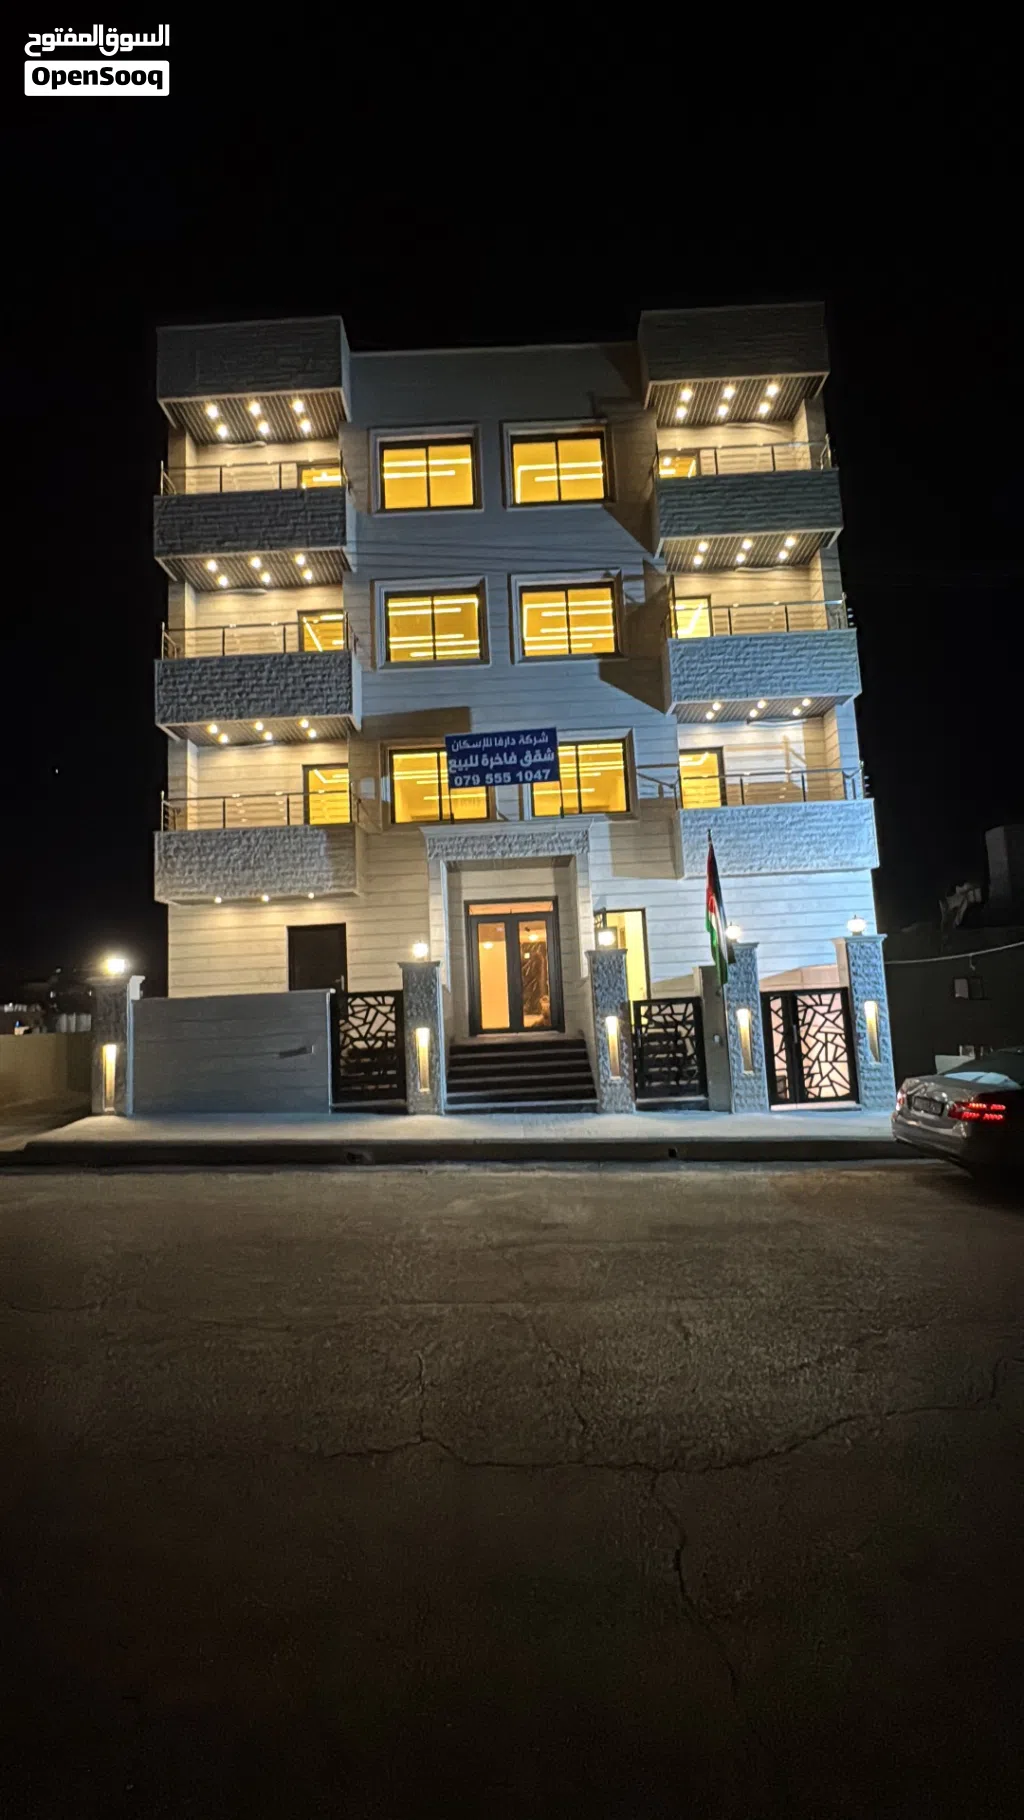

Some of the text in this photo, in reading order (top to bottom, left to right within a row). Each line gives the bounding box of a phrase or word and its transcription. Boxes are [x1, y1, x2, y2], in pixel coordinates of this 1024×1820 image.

[518, 731, 549, 746] شركة
[448, 747, 555, 773] شقق فاخرة للبيع
[454, 769, 551, 787] 079 555 1047
